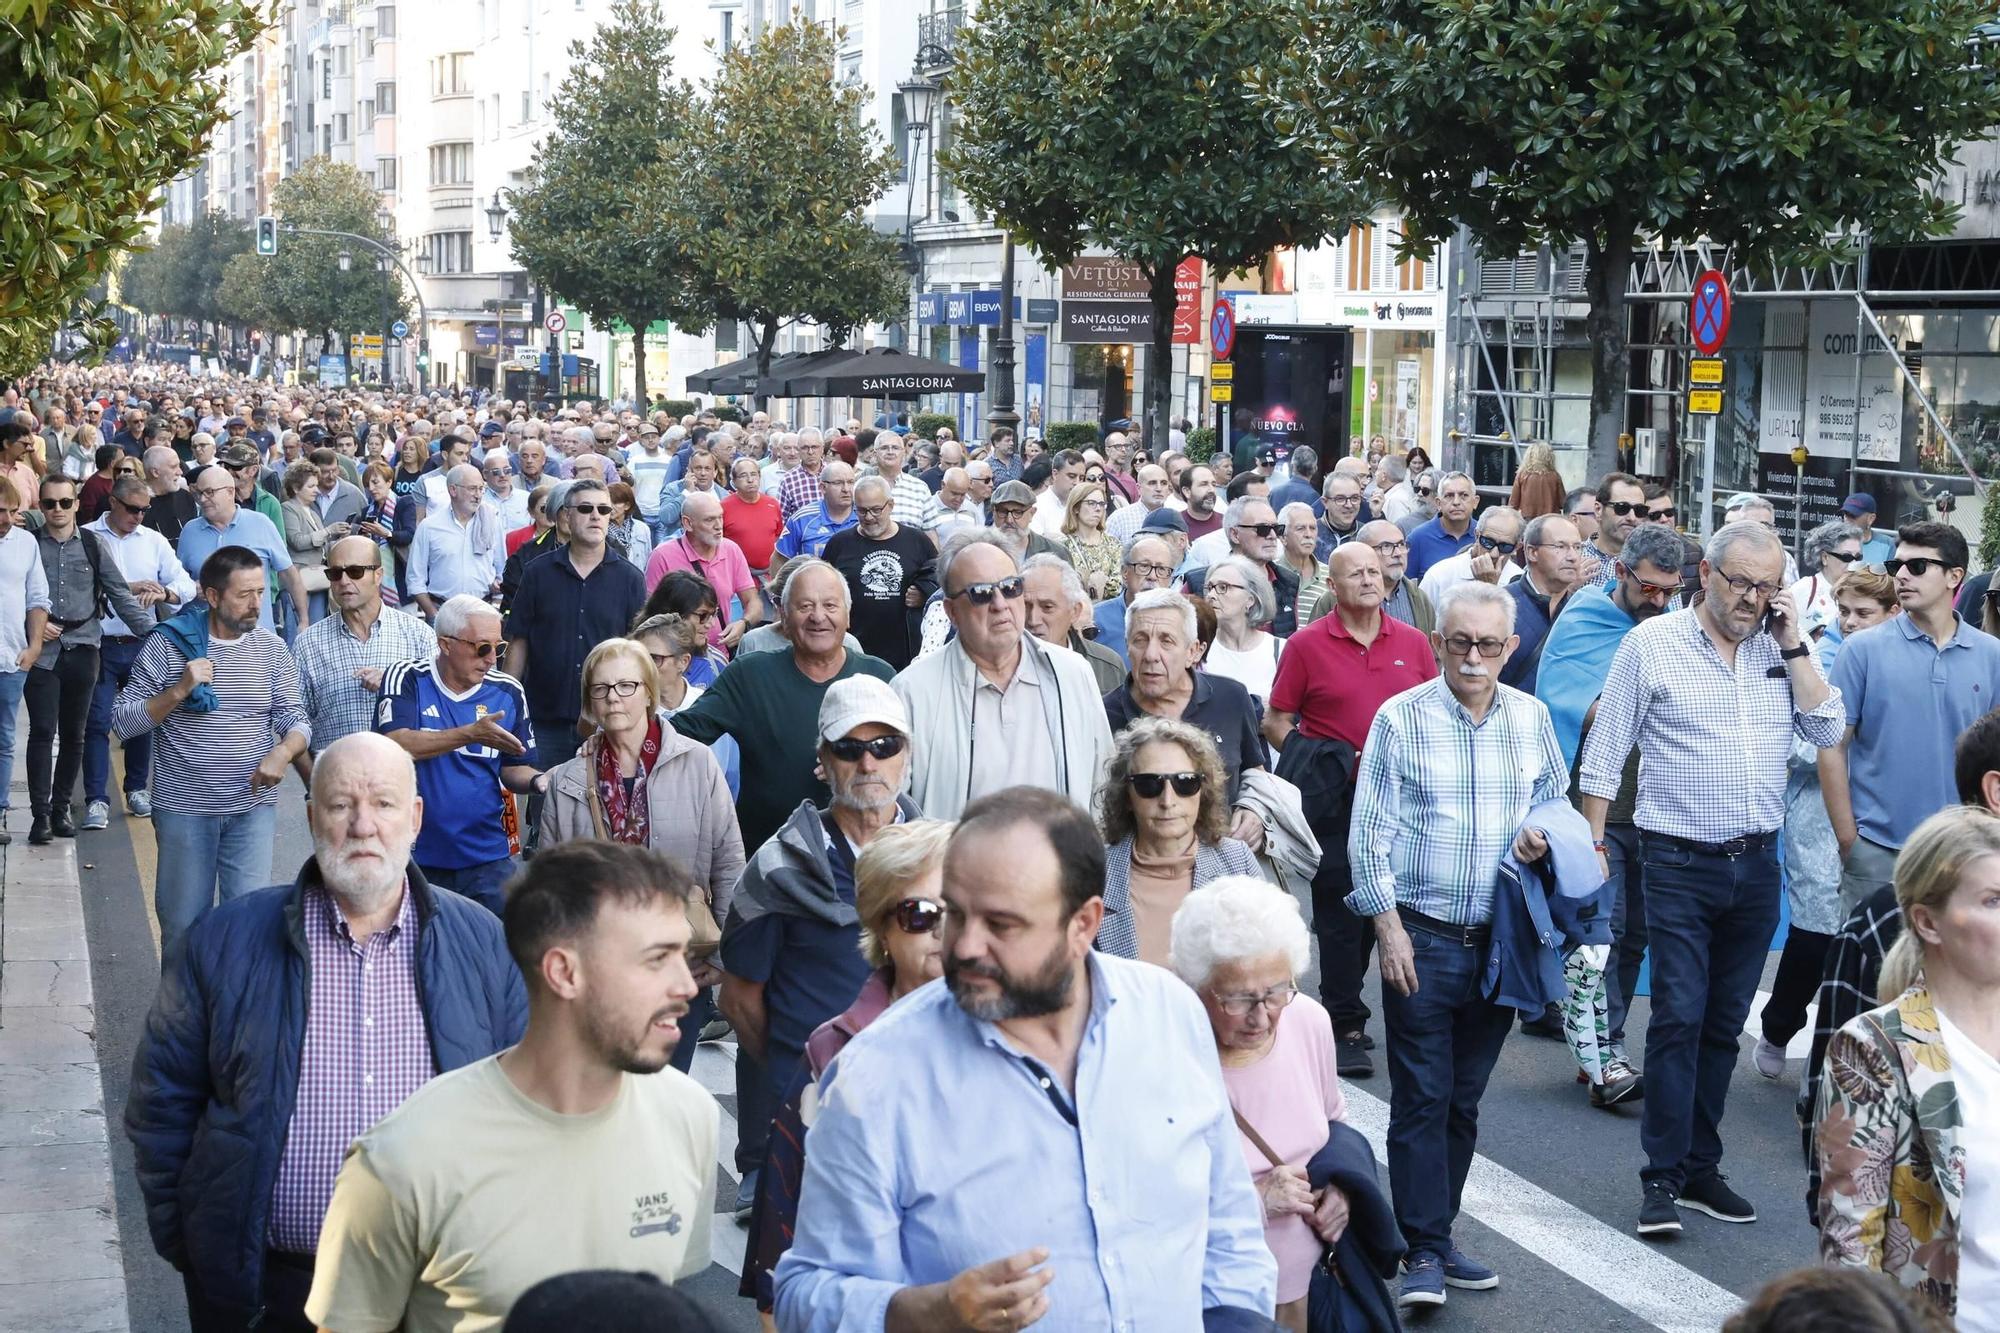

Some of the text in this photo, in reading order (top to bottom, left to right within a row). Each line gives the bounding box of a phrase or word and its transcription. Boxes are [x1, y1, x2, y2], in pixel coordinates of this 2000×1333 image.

[919, 299, 935, 318] BBVA
[949, 299, 966, 319] BBVA
[974, 303, 1002, 312] BBVA
[1828, 395, 1855, 408] Cervante
[1250, 421, 1283, 431] NUEVO
[1844, 414, 1853, 425] 23
[635, 1192, 669, 1208] VANS
